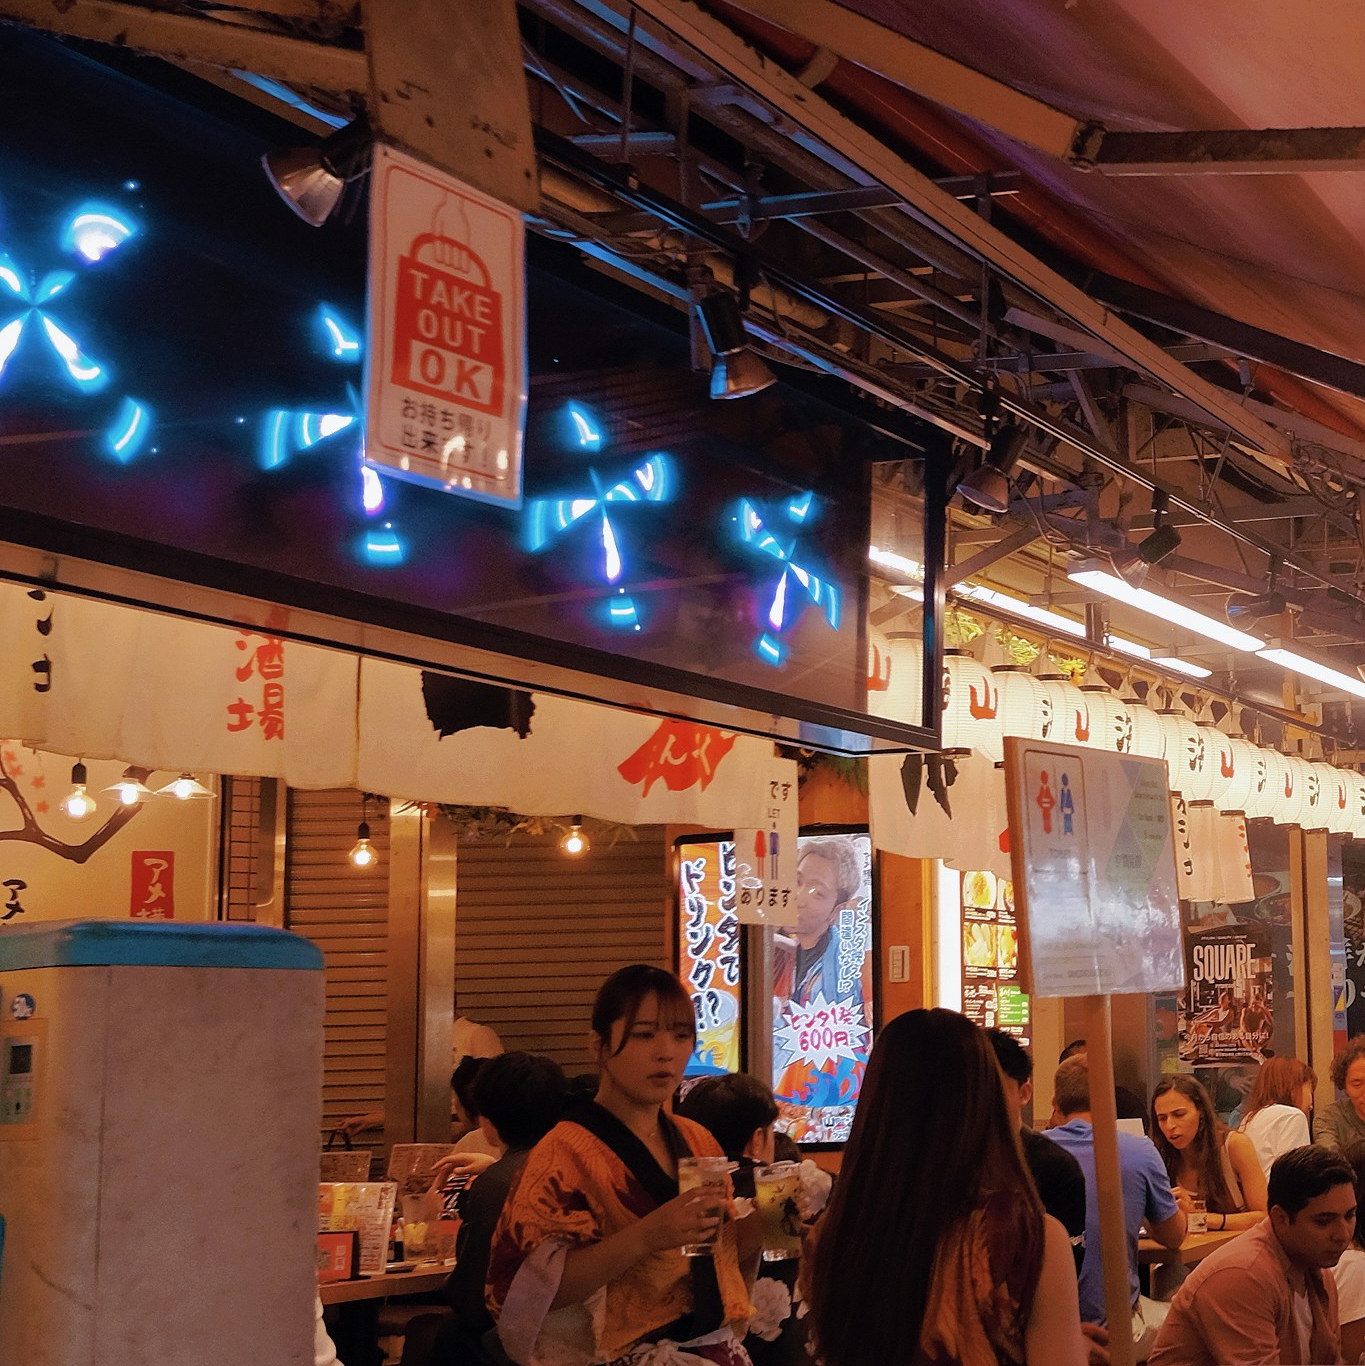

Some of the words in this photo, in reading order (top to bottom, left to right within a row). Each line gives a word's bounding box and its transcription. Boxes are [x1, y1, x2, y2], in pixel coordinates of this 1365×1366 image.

[409, 269, 493, 325] TAKE
[417, 309, 487, 355] OUT
[419, 348, 482, 400] OK
[968, 675, 999, 720] 山
[1, 878, 28, 924] アメ
[1193, 943, 1257, 984] SQUARE
[798, 1029, 850, 1053] 600円
